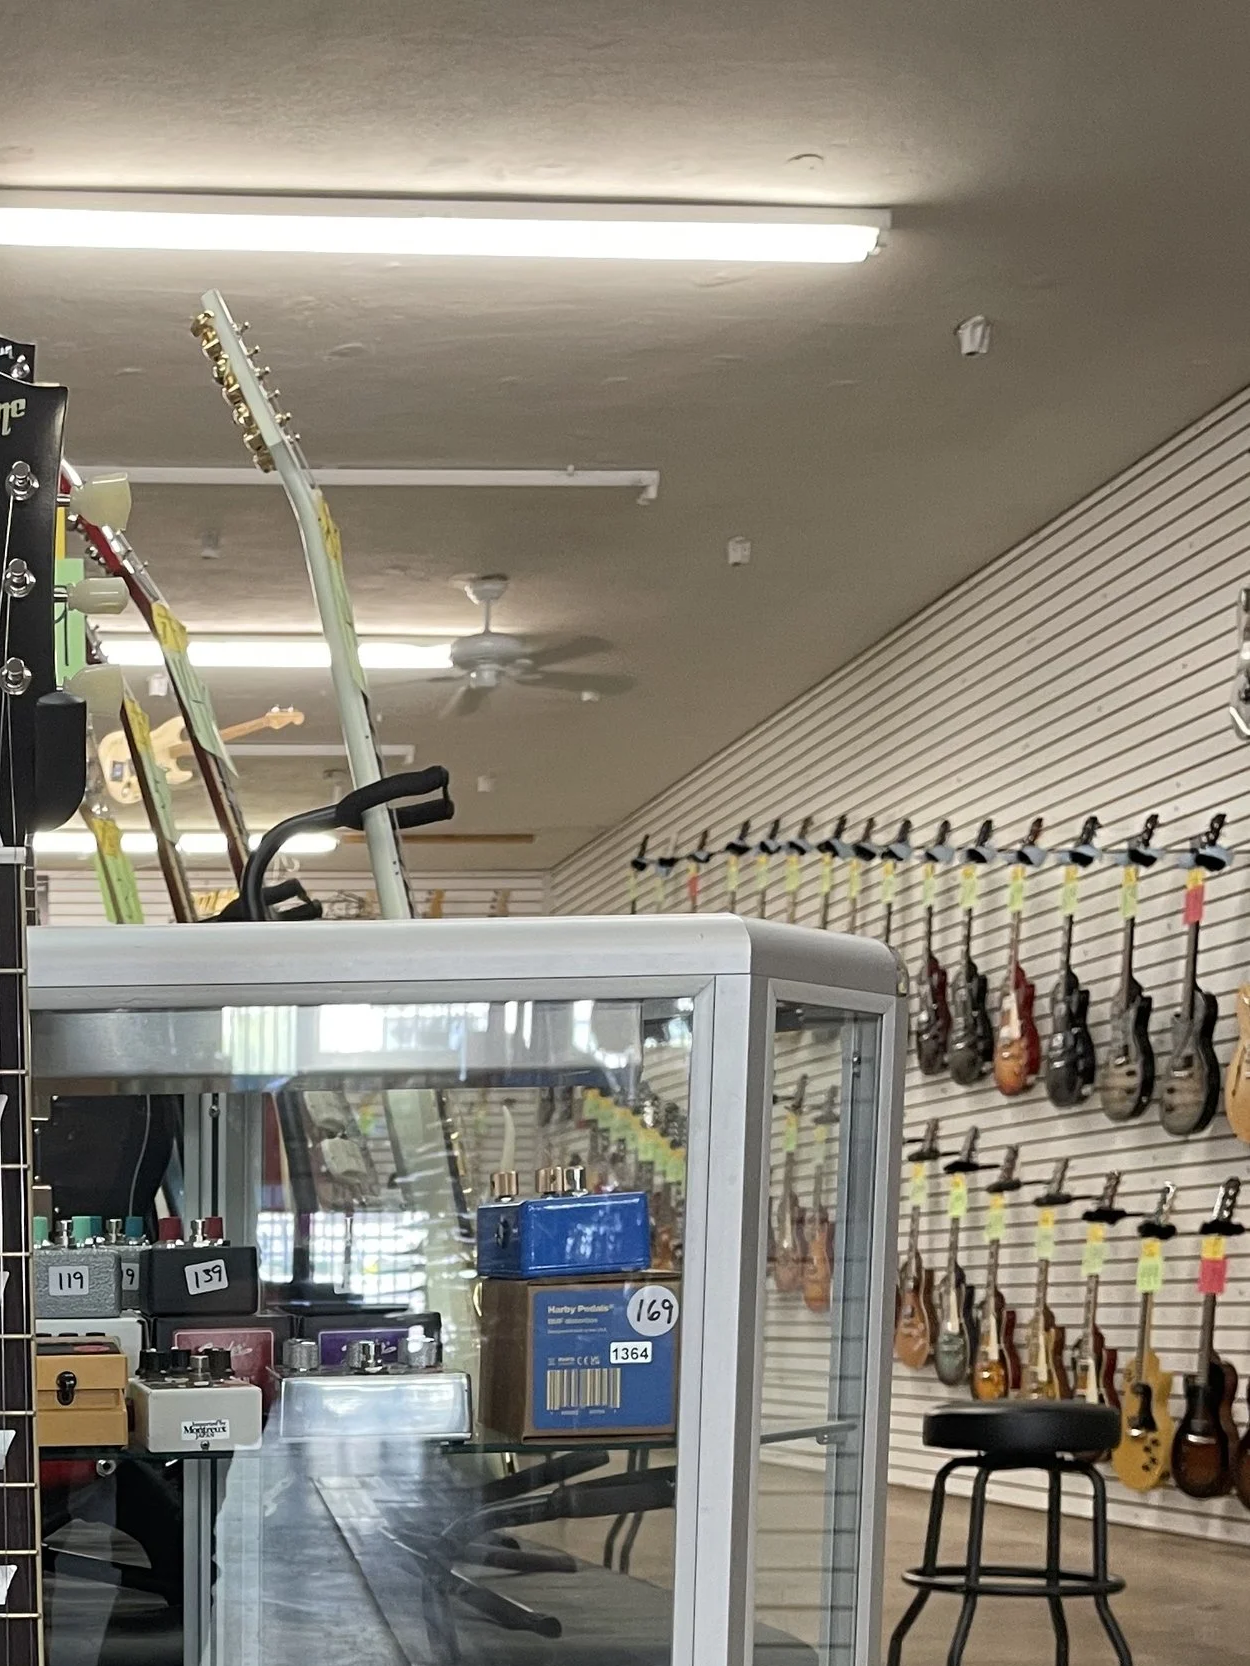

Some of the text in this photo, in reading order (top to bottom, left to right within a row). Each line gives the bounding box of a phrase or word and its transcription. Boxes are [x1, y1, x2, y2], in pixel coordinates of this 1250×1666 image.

[58, 1271, 84, 1291] 119
[194, 1264, 223, 1289] 139
[636, 1298, 675, 1325] 169
[611, 1346, 650, 1361] 1364
